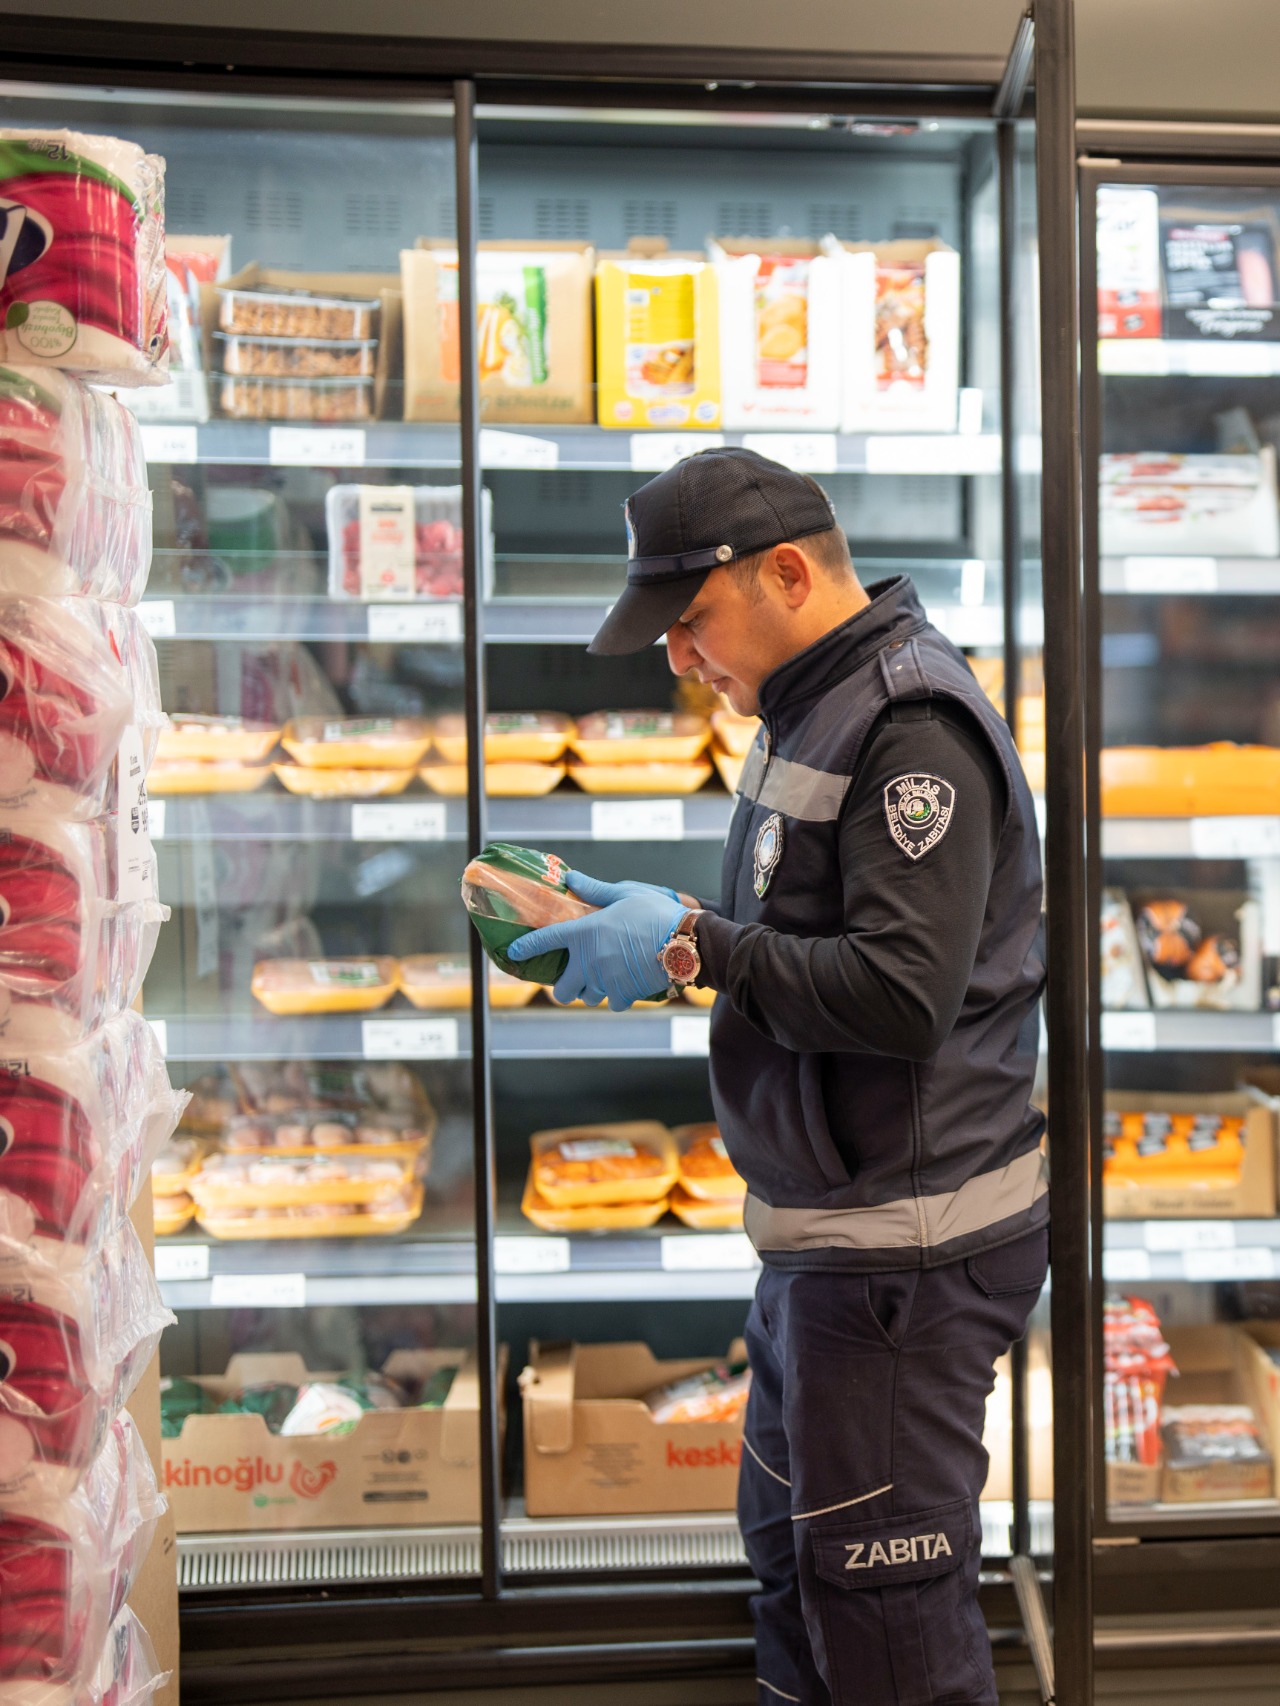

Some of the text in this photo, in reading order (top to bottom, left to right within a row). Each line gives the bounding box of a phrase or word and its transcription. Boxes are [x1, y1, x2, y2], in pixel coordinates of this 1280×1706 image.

[48, 143, 69, 160] 12
[896, 778, 940, 796] MİLAS
[917, 806, 949, 851] ZABITASI
[9, 1060, 31, 1078] 12
[845, 1533, 952, 1569] ZABITA
